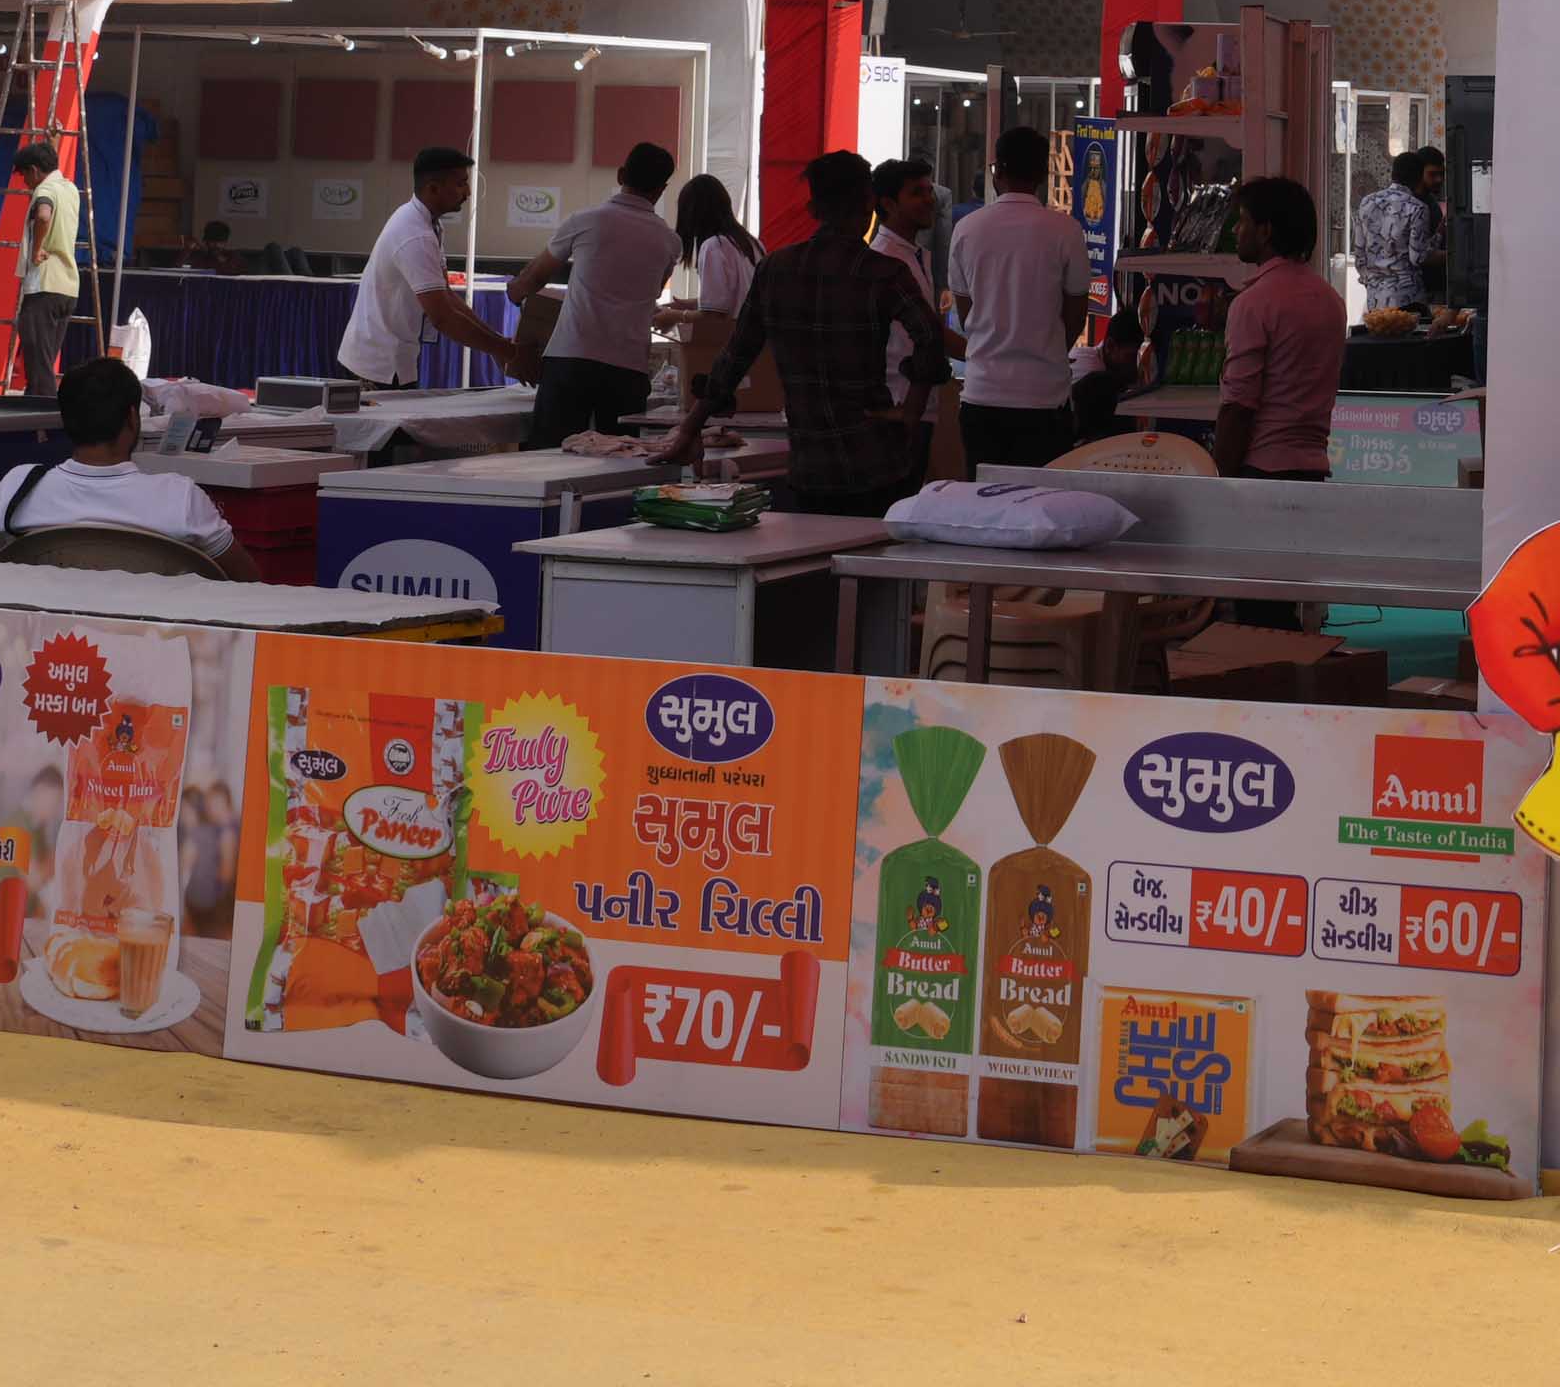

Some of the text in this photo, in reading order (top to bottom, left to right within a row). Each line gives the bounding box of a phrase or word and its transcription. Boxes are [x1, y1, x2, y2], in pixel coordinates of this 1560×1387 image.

[874, 66, 898, 82] SBC
[660, 696, 758, 746] સુમુલ
[482, 726, 568, 785] Truly
[510, 780, 591, 826] Pure
[1138, 752, 1278, 822] સુમુલ
[1375, 774, 1478, 815] Amul
[633, 792, 776, 871] સુમુલ
[574, 870, 824, 944] પનીર ચિલ્લી
[1195, 881, 1302, 946] ₹40/-
[1405, 896, 1517, 965] ₹60/-
[885, 975, 960, 1002] Bread
[1000, 979, 1073, 1007] Bread
[643, 984, 781, 1061] ₹70/-
[884, 1051, 957, 1070] SANDWICH
